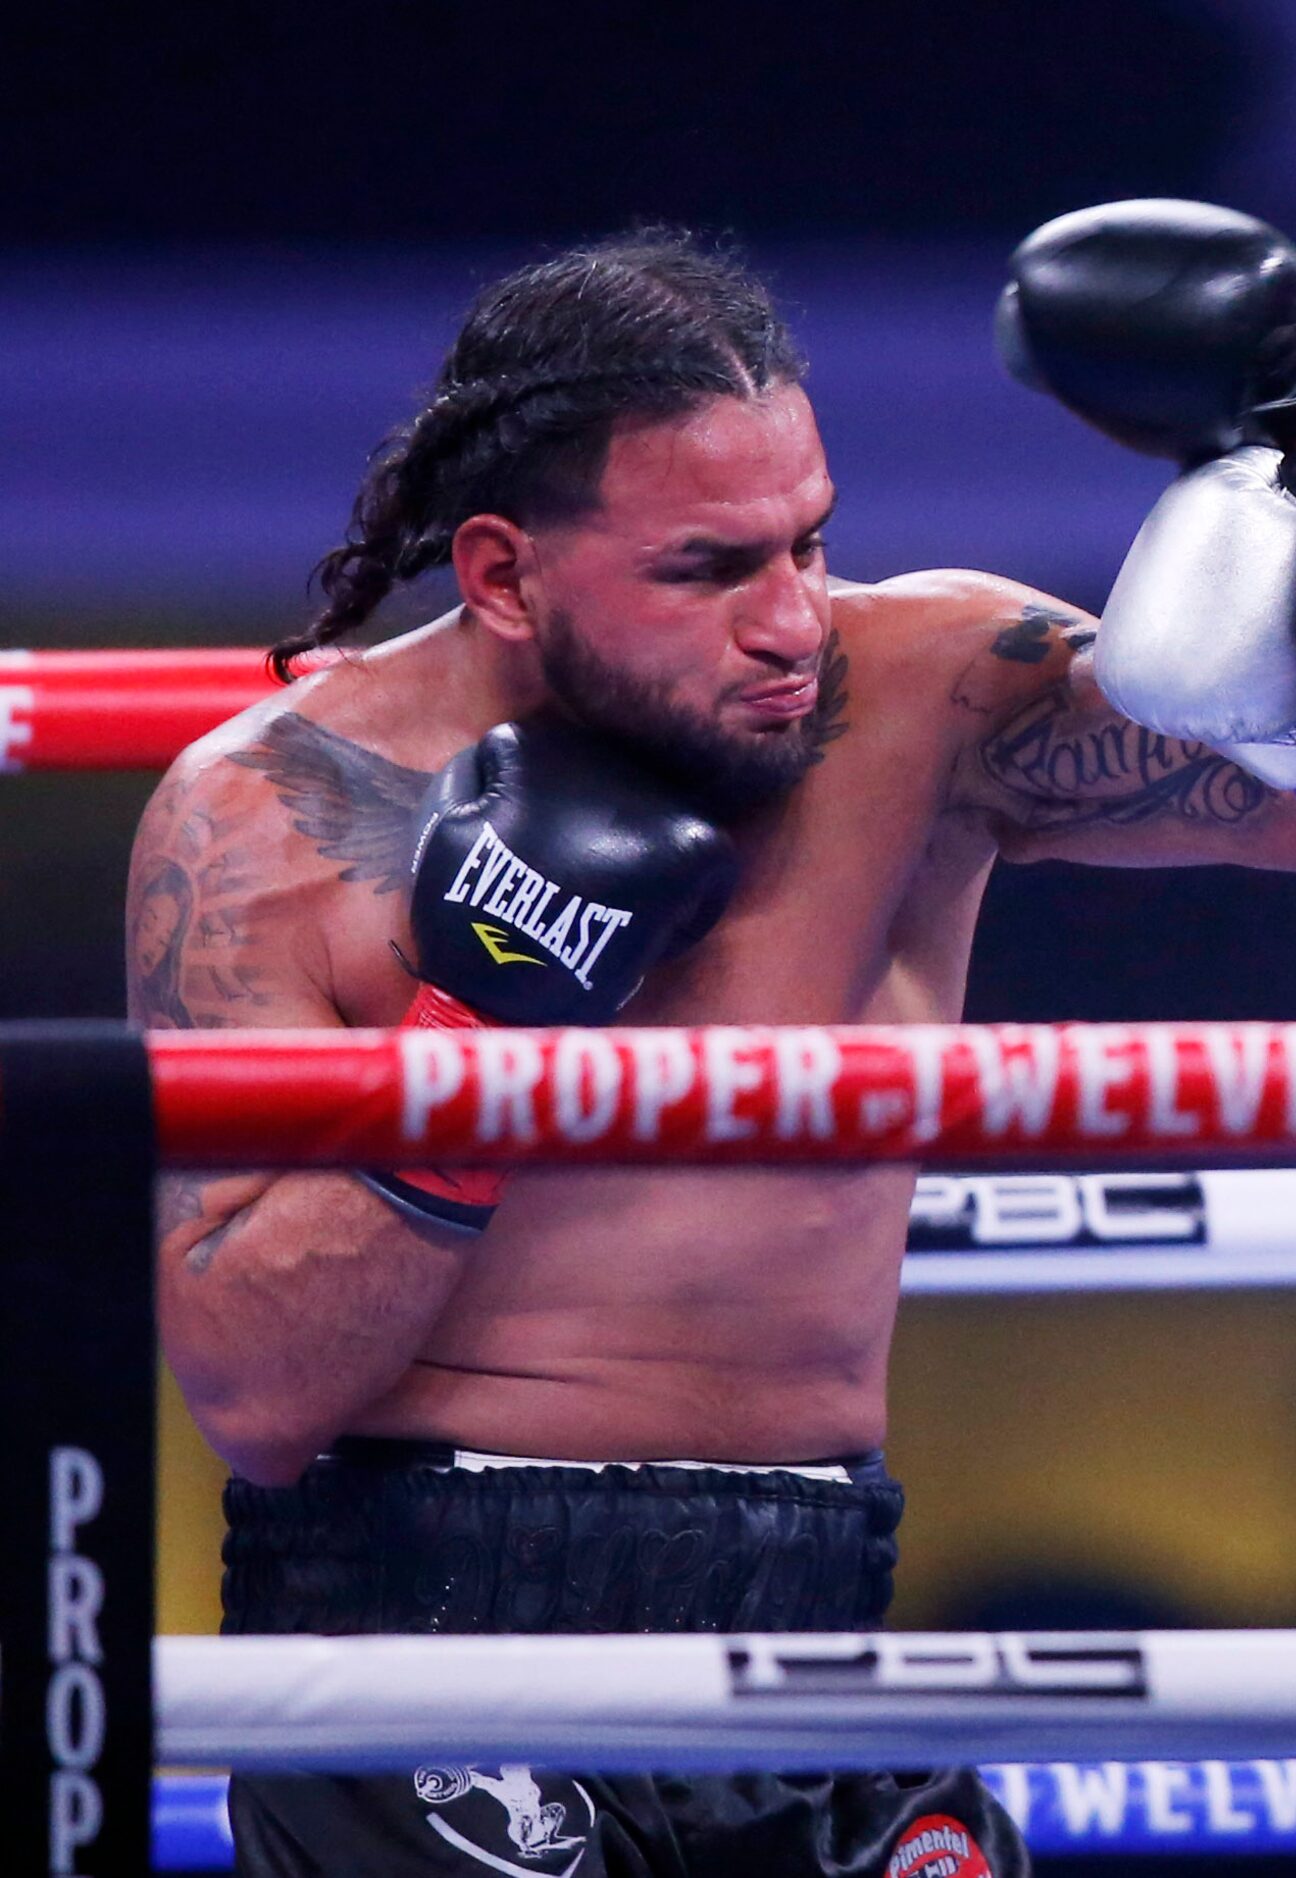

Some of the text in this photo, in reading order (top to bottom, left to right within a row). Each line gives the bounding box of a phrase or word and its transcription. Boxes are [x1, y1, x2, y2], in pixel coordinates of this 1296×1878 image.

[443, 820, 634, 984] EVERLAST
[401, 1027, 843, 1142] PROPER
[889, 1824, 971, 1878] Pimentel
